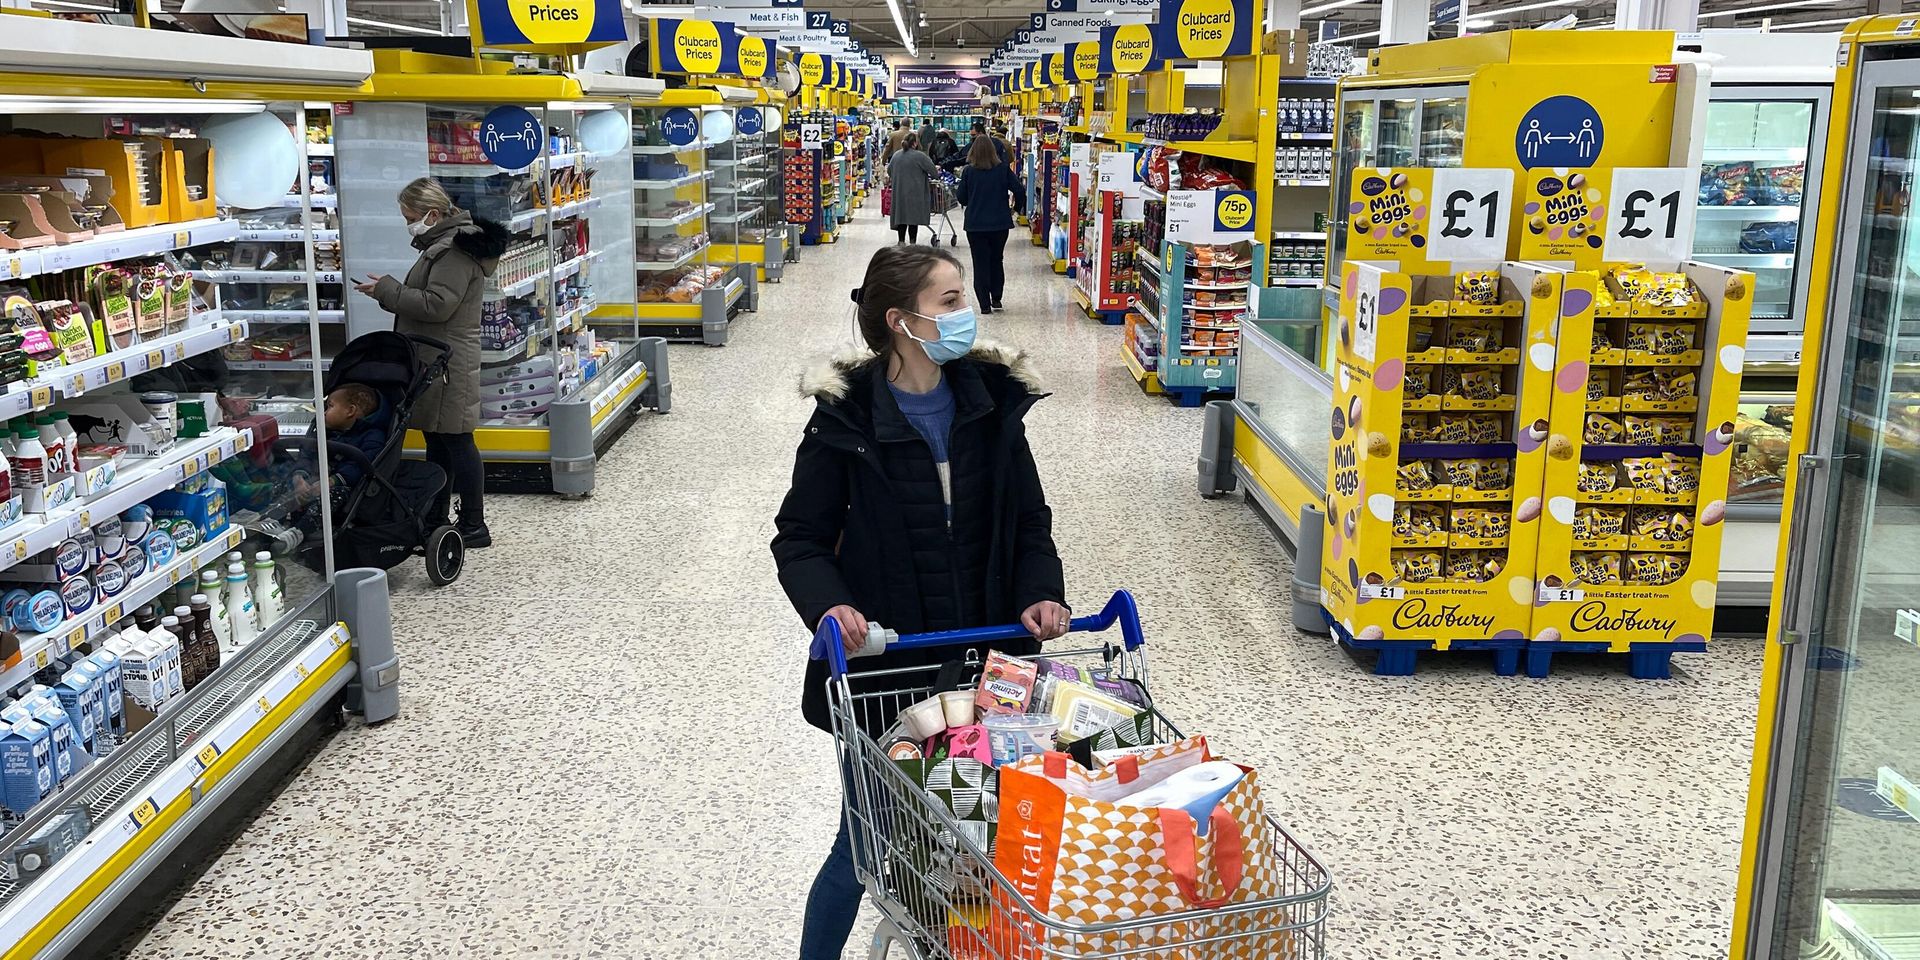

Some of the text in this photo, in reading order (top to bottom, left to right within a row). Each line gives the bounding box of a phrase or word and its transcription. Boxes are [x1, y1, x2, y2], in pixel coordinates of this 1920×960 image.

[530, 5, 579, 21] Prices
[782, 13, 799, 21] Fish
[1182, 10, 1230, 25] Clubcard
[812, 14, 827, 27] 27
[1034, 16, 1112, 28] 9 Canned Foods
[833, 23, 847, 34] 26
[803, 34, 827, 42] Poultry
[1018, 32, 1056, 44] 10 Cereal
[1189, 28, 1222, 41] Prices
[678, 36, 718, 48] Clubcard
[848, 41, 858, 50] 25
[1006, 40, 1015, 49] 11
[1116, 39, 1150, 50] Clubcard
[686, 48, 712, 60] Prices
[740, 48, 766, 58] Clubcard
[1120, 50, 1143, 60] Prices
[744, 58, 762, 67] Prices
[800, 62, 822, 70] Clubcard
[1080, 62, 1096, 70] Prices
[902, 76, 958, 86] Health & Beauty
[804, 129, 820, 142] £2
[1183, 202, 1196, 210] Eggs
[1224, 200, 1247, 214] 75p
[1370, 190, 1406, 213] Mini
[1546, 190, 1582, 213] Mini
[1372, 204, 1411, 224] eggs
[1440, 190, 1499, 238] £1
[1547, 205, 1588, 224] eggs
[1618, 190, 1680, 238] £1
[1170, 224, 1180, 232] £1
[324, 274, 336, 282] £8
[1470, 284, 1492, 294] Mini
[1472, 292, 1494, 300] eggs
[1358, 292, 1376, 334] £1
[62, 326, 82, 336] Garden
[1664, 338, 1684, 346] Mini
[1665, 345, 1688, 354] eggs
[1470, 384, 1488, 394] Mini
[38, 392, 45, 400] £2
[1446, 422, 1464, 433] Mini
[1478, 422, 1496, 433] Mini
[1448, 430, 1467, 441] eggs
[1480, 430, 1498, 440] eggs
[1634, 429, 1654, 440] Mini
[1662, 433, 1682, 442] Mini
[1334, 439, 1356, 470] Mini
[1482, 470, 1501, 480] Mini
[1334, 469, 1358, 497] eggs
[1636, 481, 1656, 490] Mini
[1600, 526, 1620, 534] eggs
[150, 540, 171, 554] PHILADELPHIA
[57, 548, 82, 565] PHILADELPHIA
[1452, 556, 1472, 566] Mini
[1414, 565, 1432, 576] Mini
[1454, 564, 1473, 572] eggs
[1640, 565, 1658, 574] Mini
[96, 570, 122, 583] PHILADELPHIA
[1638, 572, 1660, 581] eggs
[62, 584, 90, 600] PHILADELPHIA
[1380, 588, 1394, 598] £1
[1560, 590, 1574, 600] £1
[34, 601, 61, 620] PHILADELPHIA
[110, 608, 116, 618] £2
[1392, 598, 1495, 635] Cadbury
[1570, 600, 1676, 639] Cadbury
[74, 632, 80, 640] £2
[168, 656, 178, 670] LY!
[152, 666, 164, 682] LY!
[108, 678, 120, 692] LY!
[990, 682, 1023, 698] Actimel
[82, 701, 92, 716] LY!
[57, 736, 70, 753] LY!
[37, 750, 50, 768] LY!
